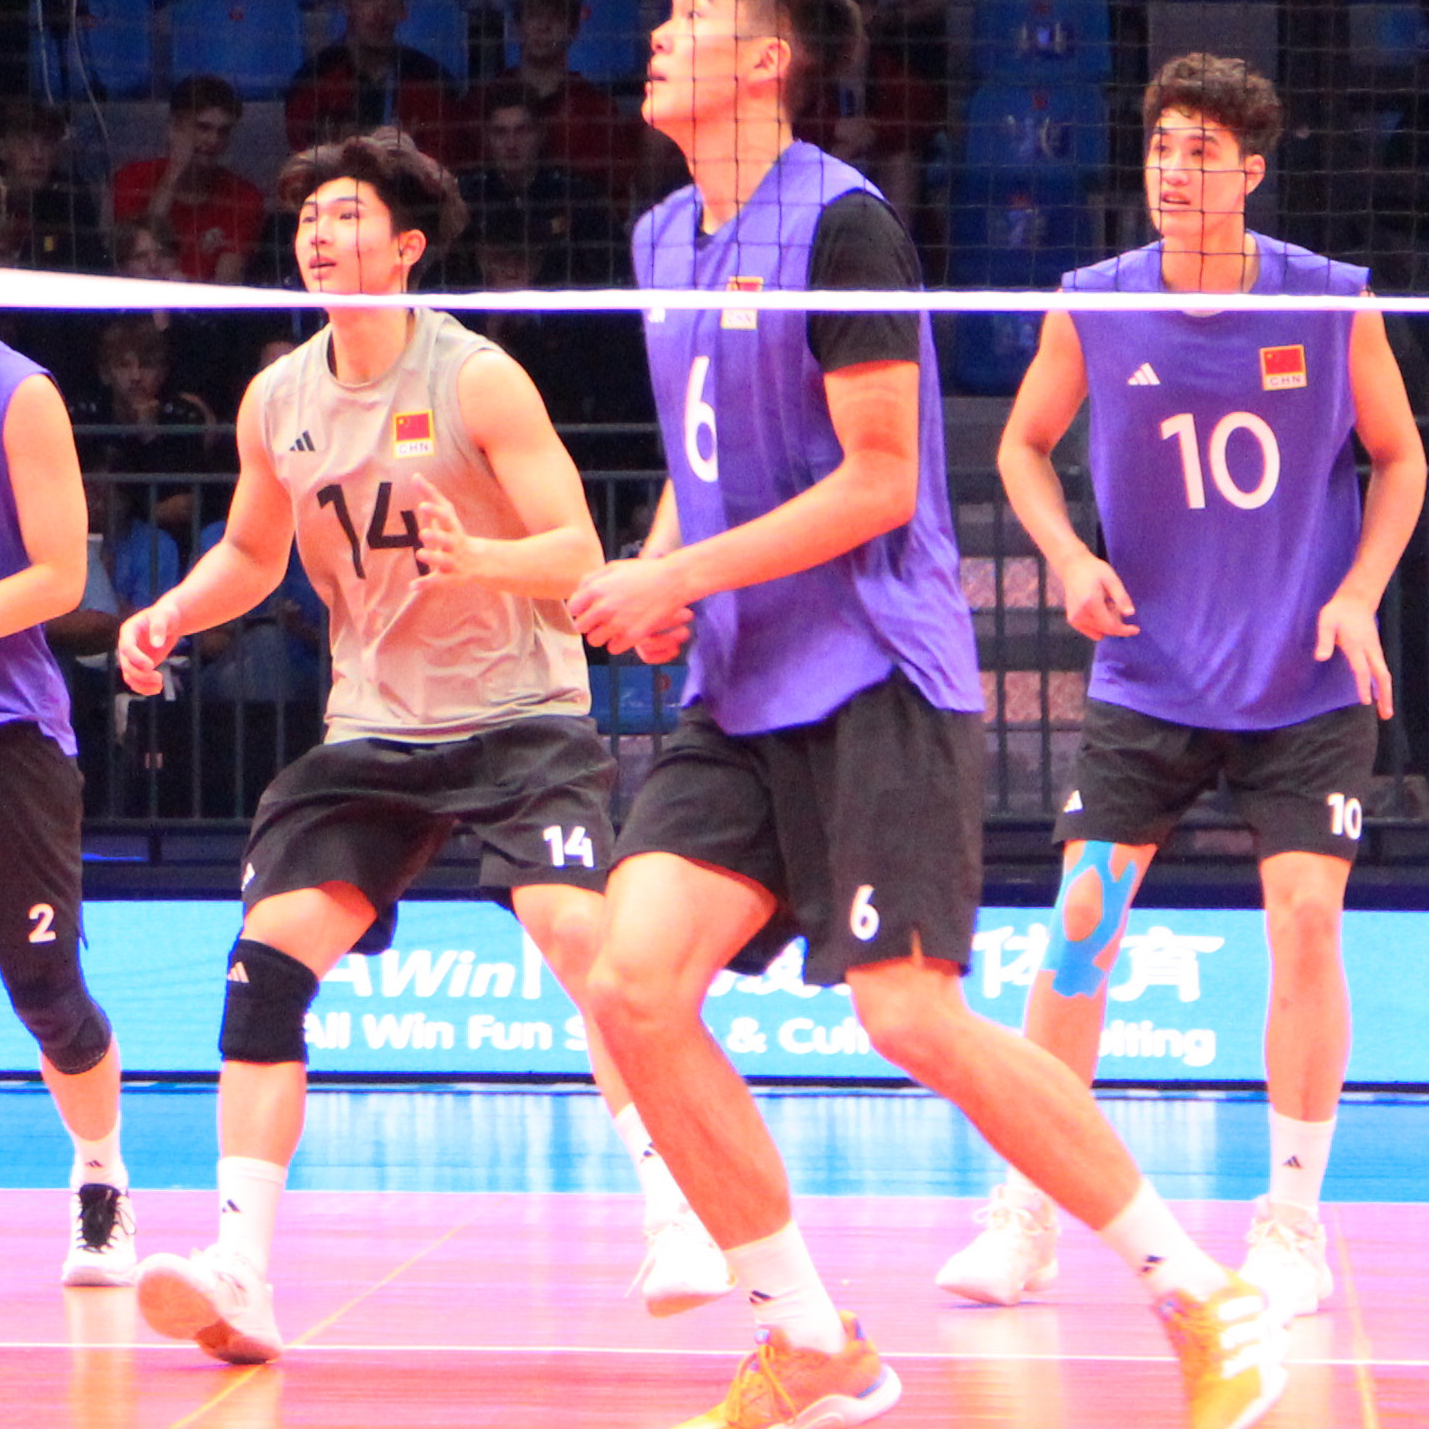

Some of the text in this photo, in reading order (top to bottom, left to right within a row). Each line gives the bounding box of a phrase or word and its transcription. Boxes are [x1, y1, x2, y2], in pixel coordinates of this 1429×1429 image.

[1270, 375, 1302, 387] CHN
[684, 355, 719, 483] 6
[398, 442, 430, 455] CHN
[1160, 412, 1281, 510] 10
[316, 481, 432, 580] 14
[1327, 793, 1362, 840] 10
[542, 825, 596, 868] 14
[28, 904, 56, 943] 2
[849, 885, 880, 940] 6
[361, 1012, 455, 1050] Win
[467, 1014, 553, 1051] Fun
[726, 1017, 767, 1054] &
